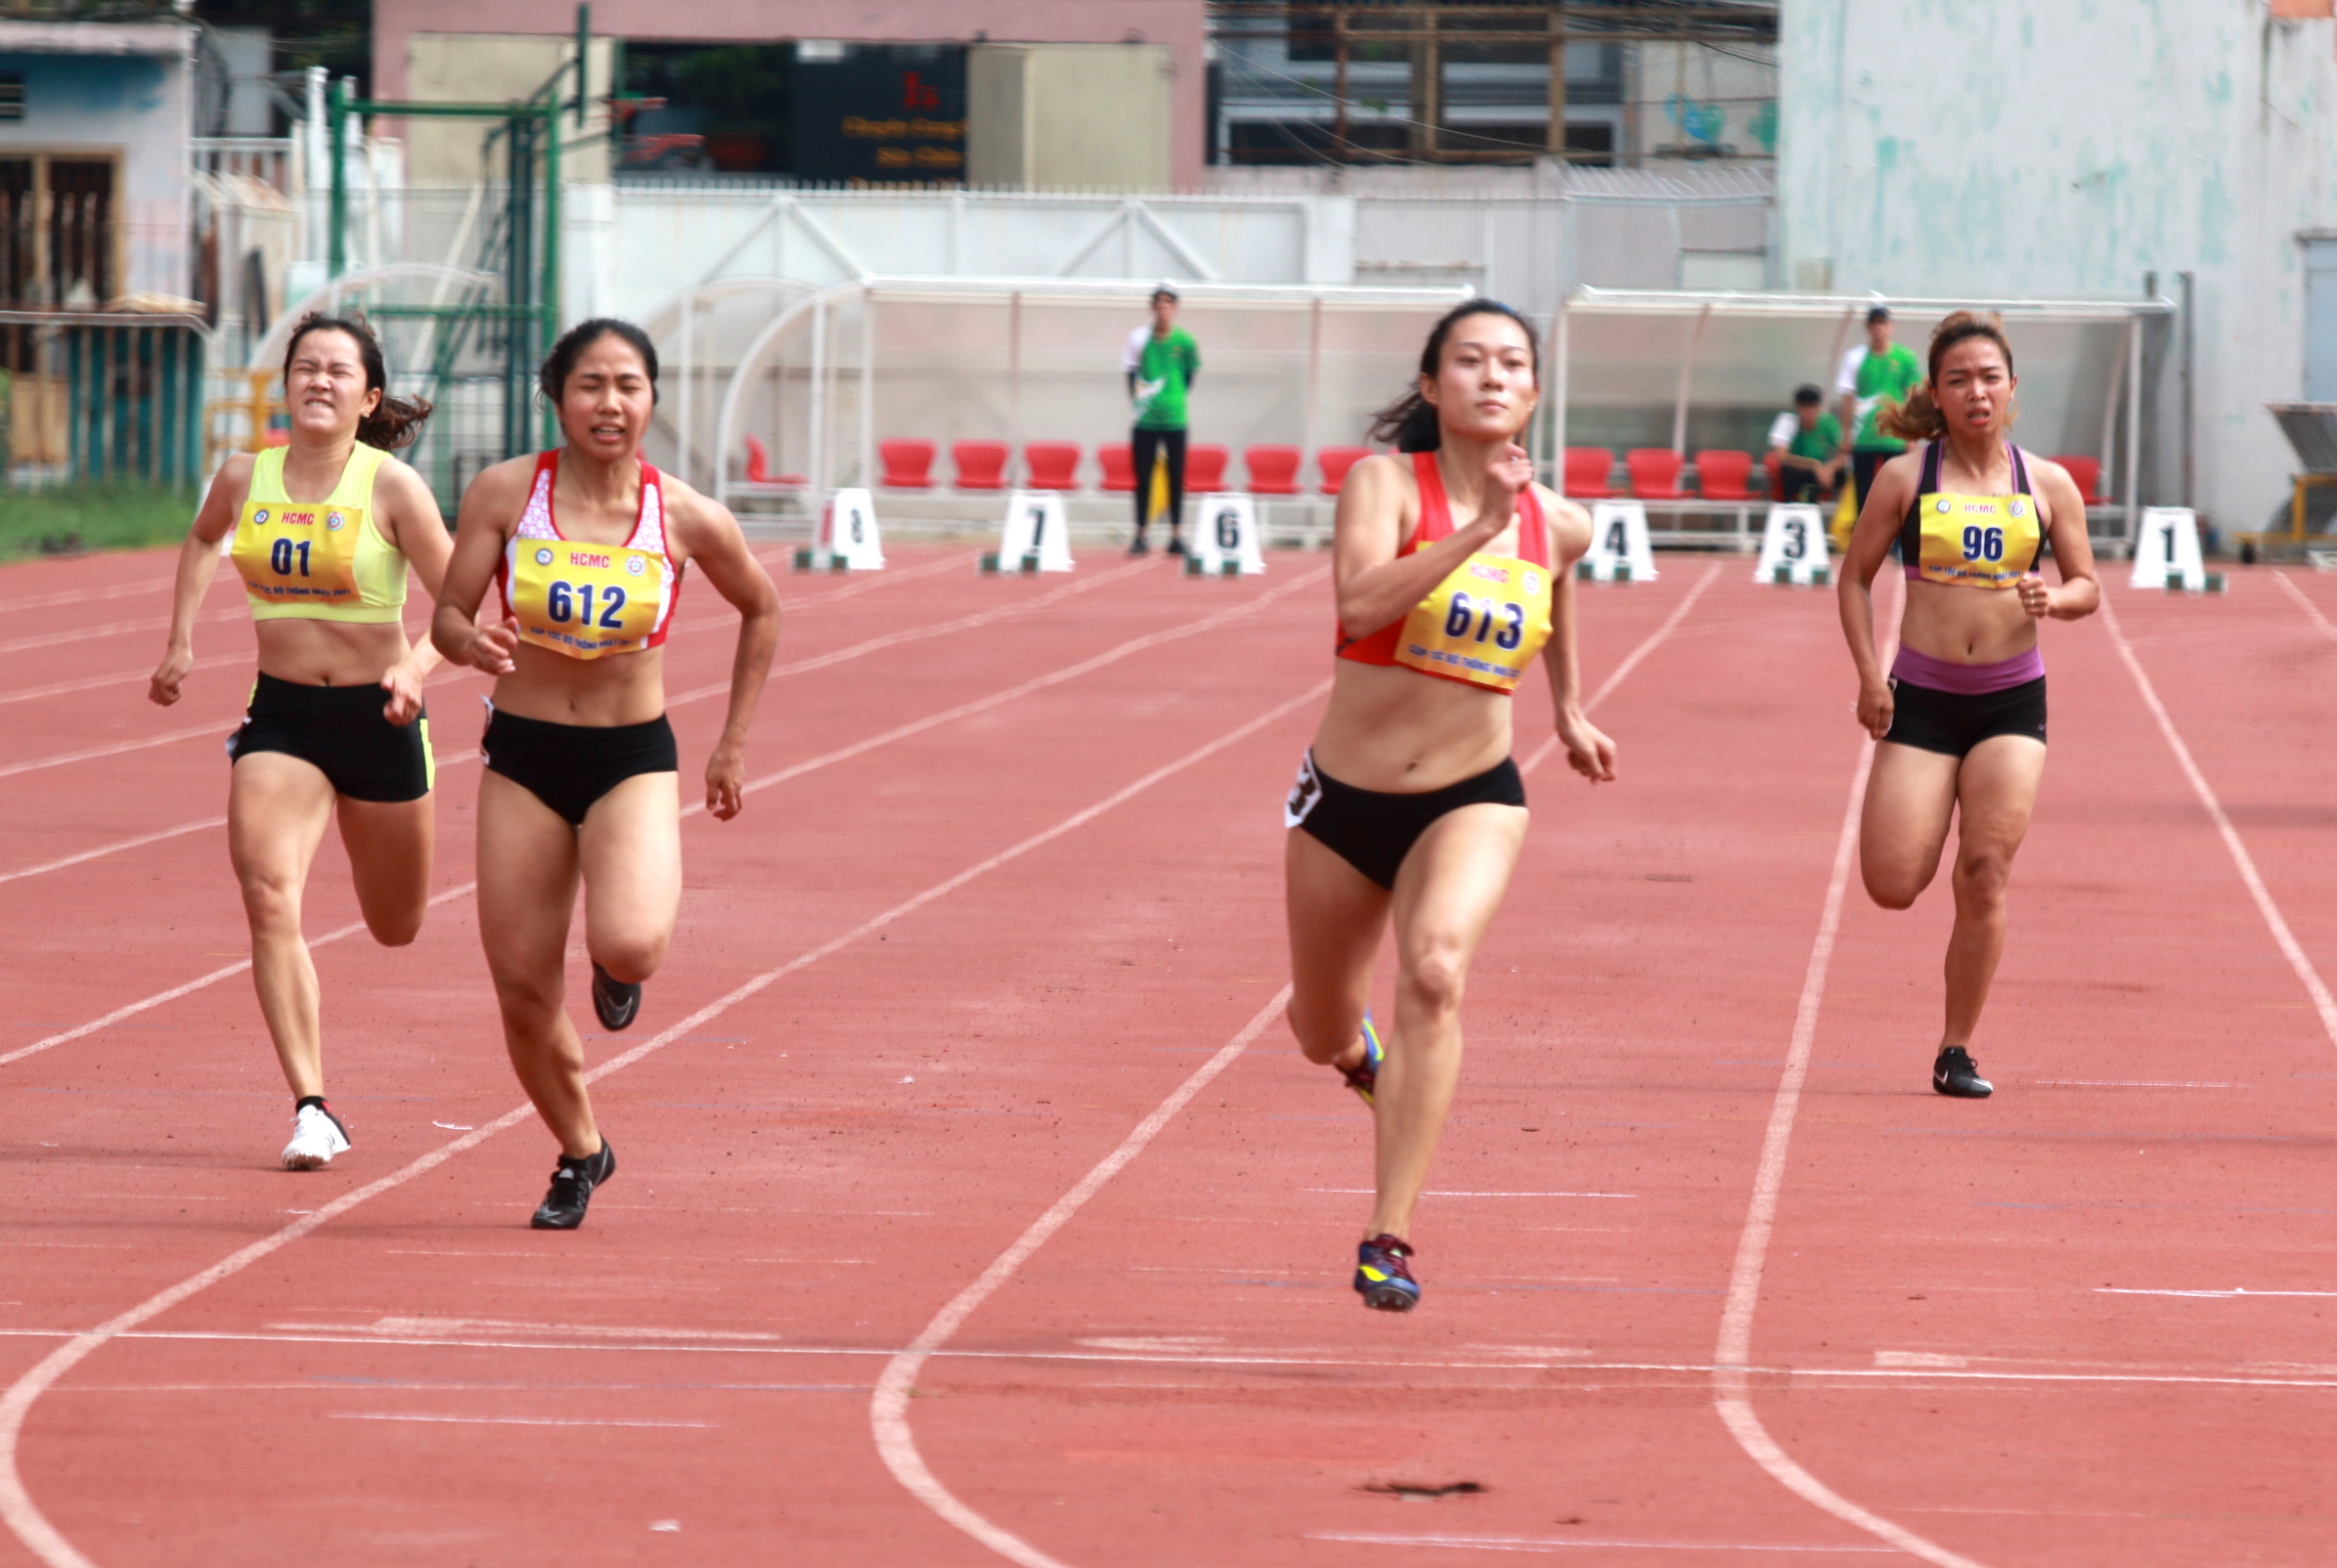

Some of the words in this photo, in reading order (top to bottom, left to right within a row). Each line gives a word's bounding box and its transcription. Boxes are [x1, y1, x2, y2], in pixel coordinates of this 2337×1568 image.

[281, 512, 315, 526] HCMC
[851, 508, 863, 544] 8
[1026, 507, 1045, 548] 7
[1963, 503, 1997, 515] HCMC
[1215, 509, 1239, 550] 6
[1605, 518, 1627, 557] 4
[1783, 518, 1806, 560] 3
[1962, 525, 2004, 563] 96
[2159, 524, 2175, 563] 1
[271, 538, 311, 578] 01
[570, 552, 610, 569] HCMC
[1470, 562, 1509, 584] HCMC
[548, 581, 626, 630] 612
[1445, 591, 1524, 651] 613
